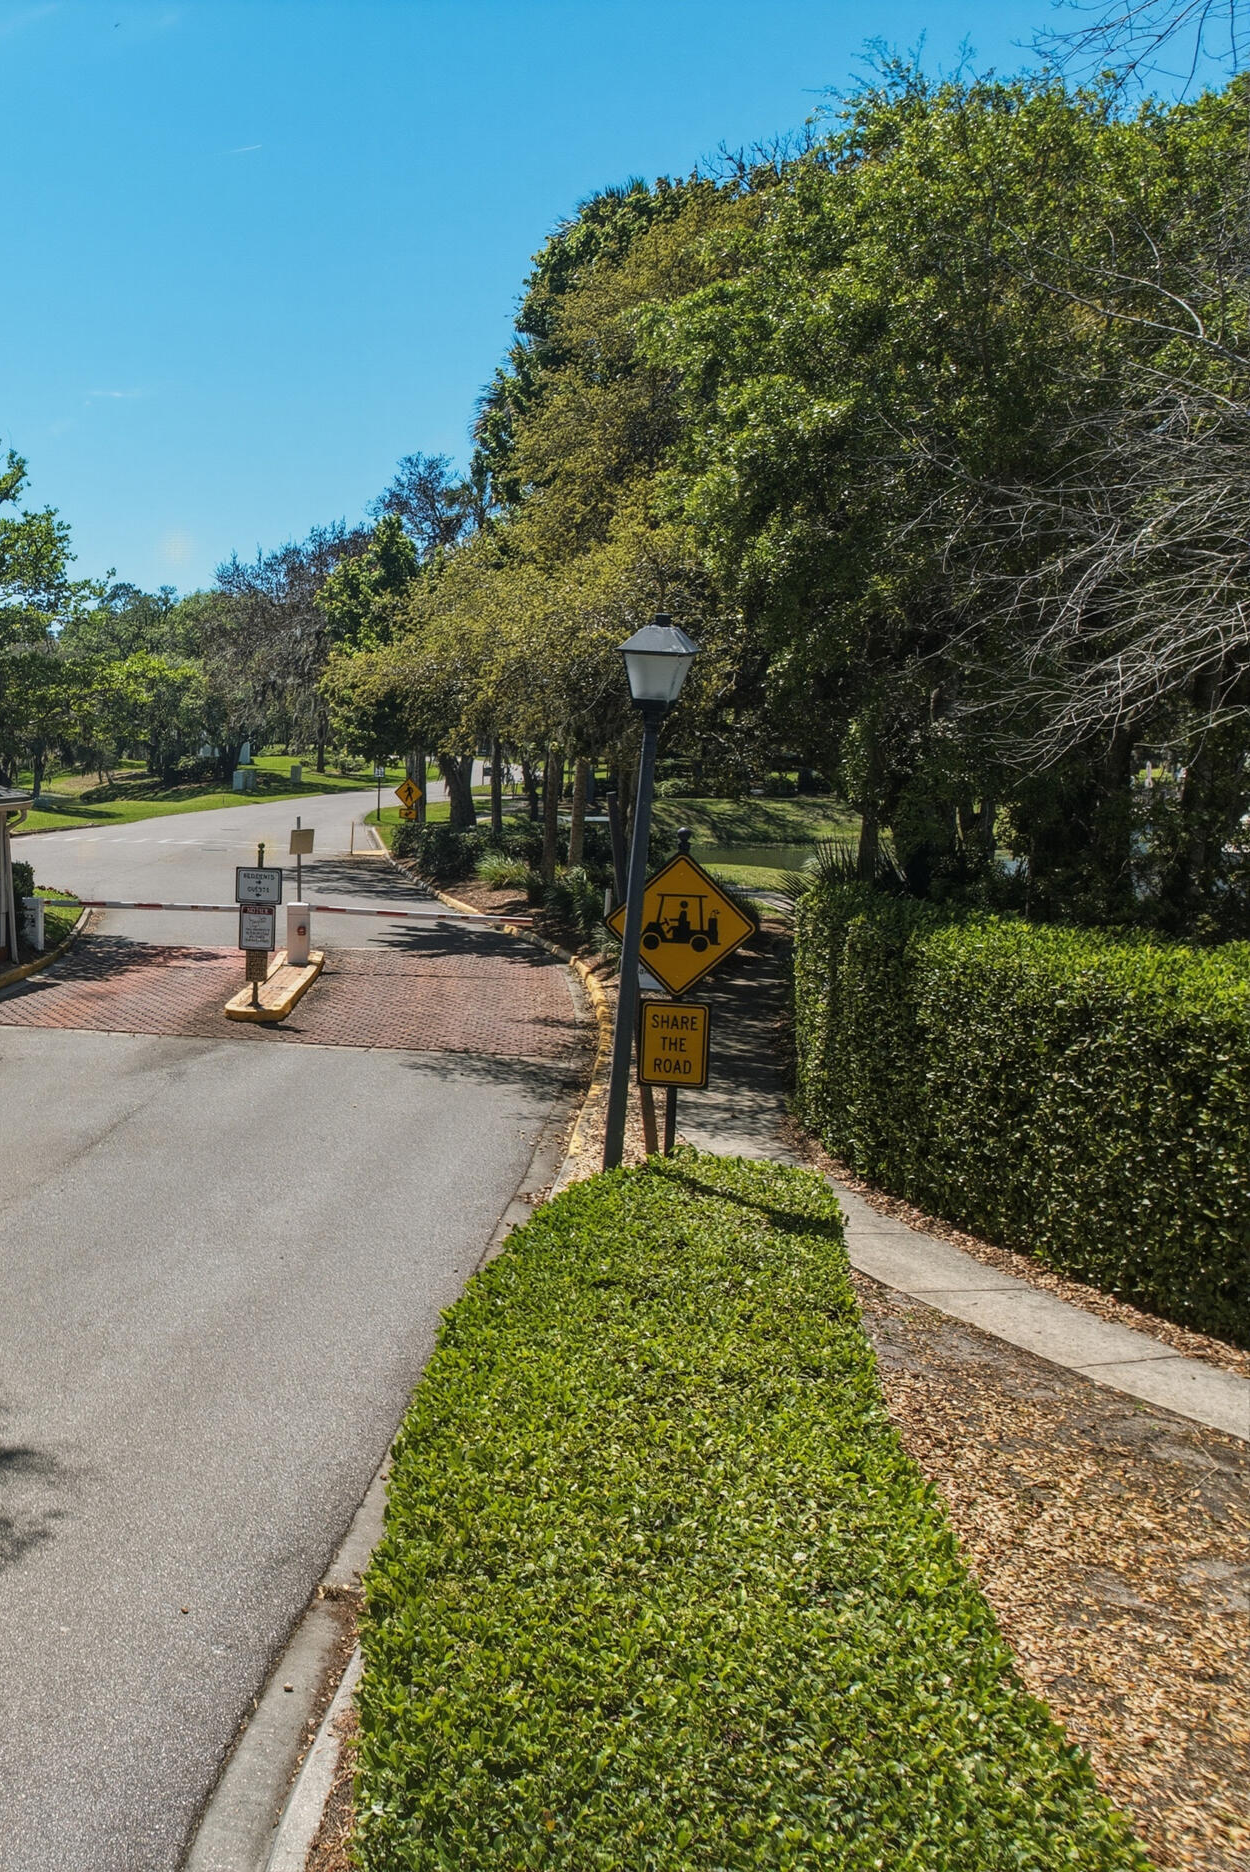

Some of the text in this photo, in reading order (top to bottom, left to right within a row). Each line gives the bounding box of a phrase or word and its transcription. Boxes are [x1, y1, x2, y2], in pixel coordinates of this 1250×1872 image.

[651, 1013, 699, 1032] SHARE
[659, 1035, 687, 1053] THE
[653, 1057, 692, 1075] ROAD
